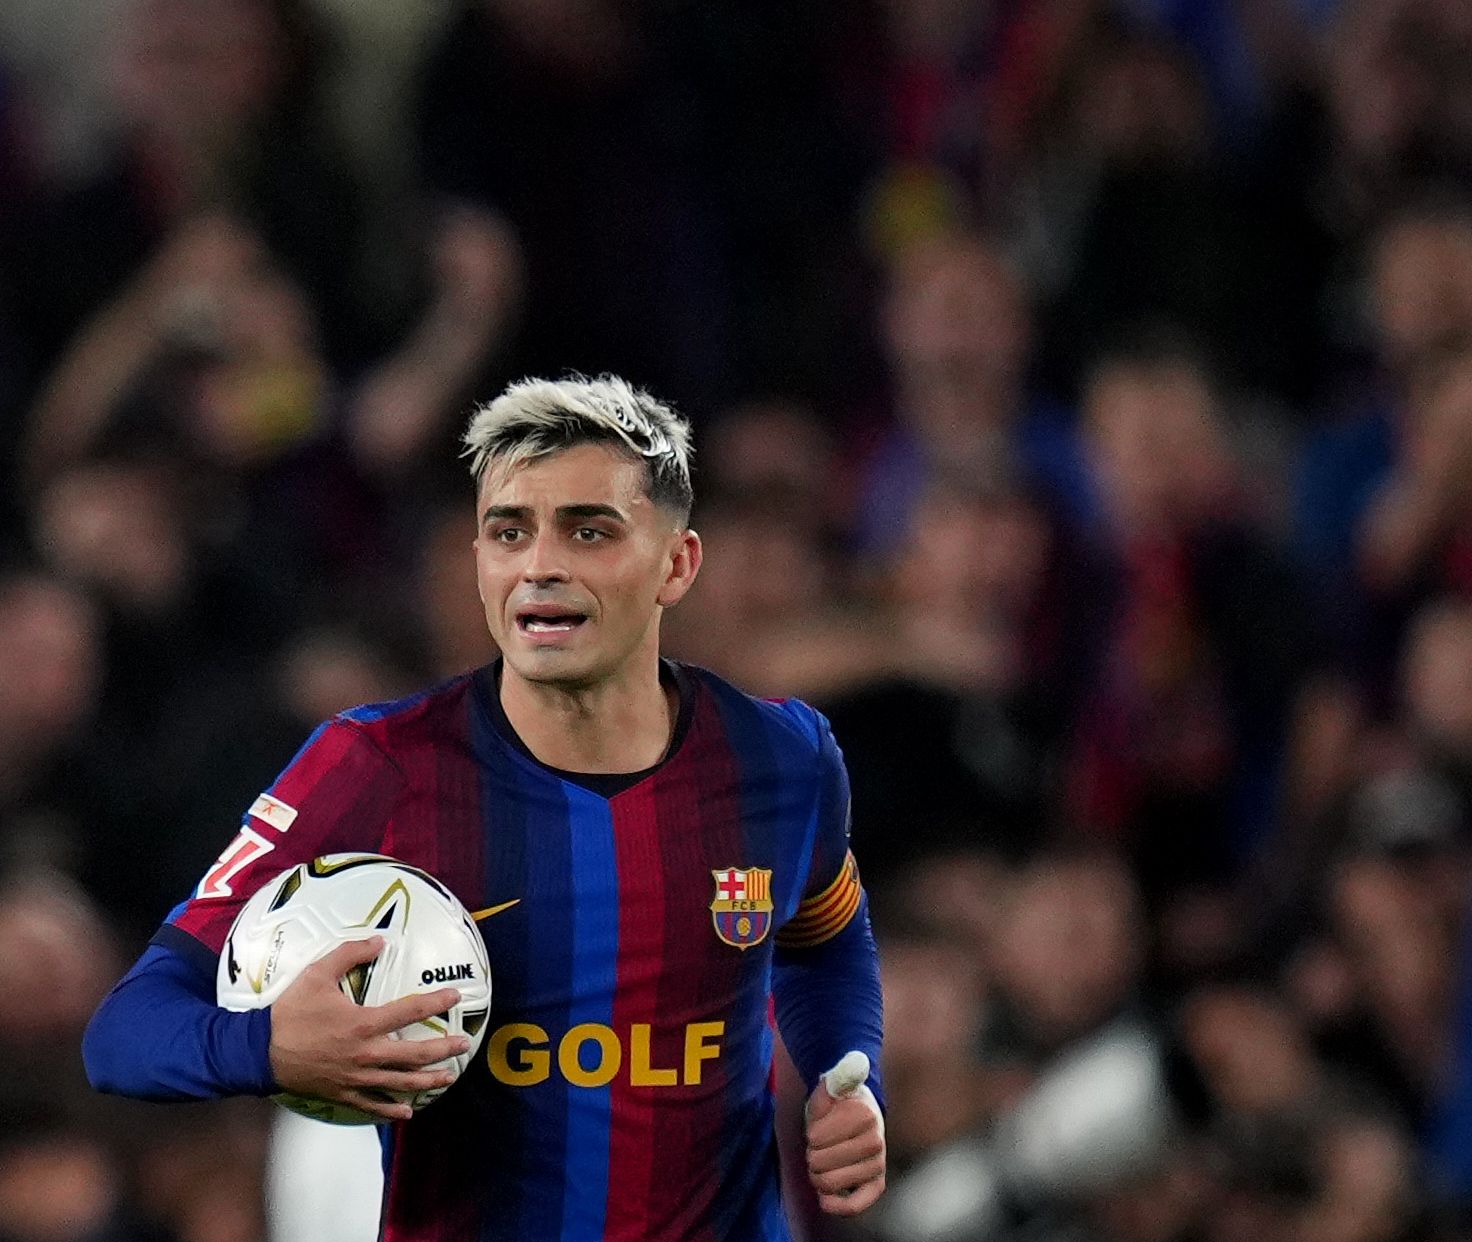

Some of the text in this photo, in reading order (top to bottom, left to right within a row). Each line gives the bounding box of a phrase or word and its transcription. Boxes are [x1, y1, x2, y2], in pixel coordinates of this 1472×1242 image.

[731, 901, 758, 911] FCB
[421, 962, 476, 985] NITRO
[487, 1021, 725, 1087] GOLF
